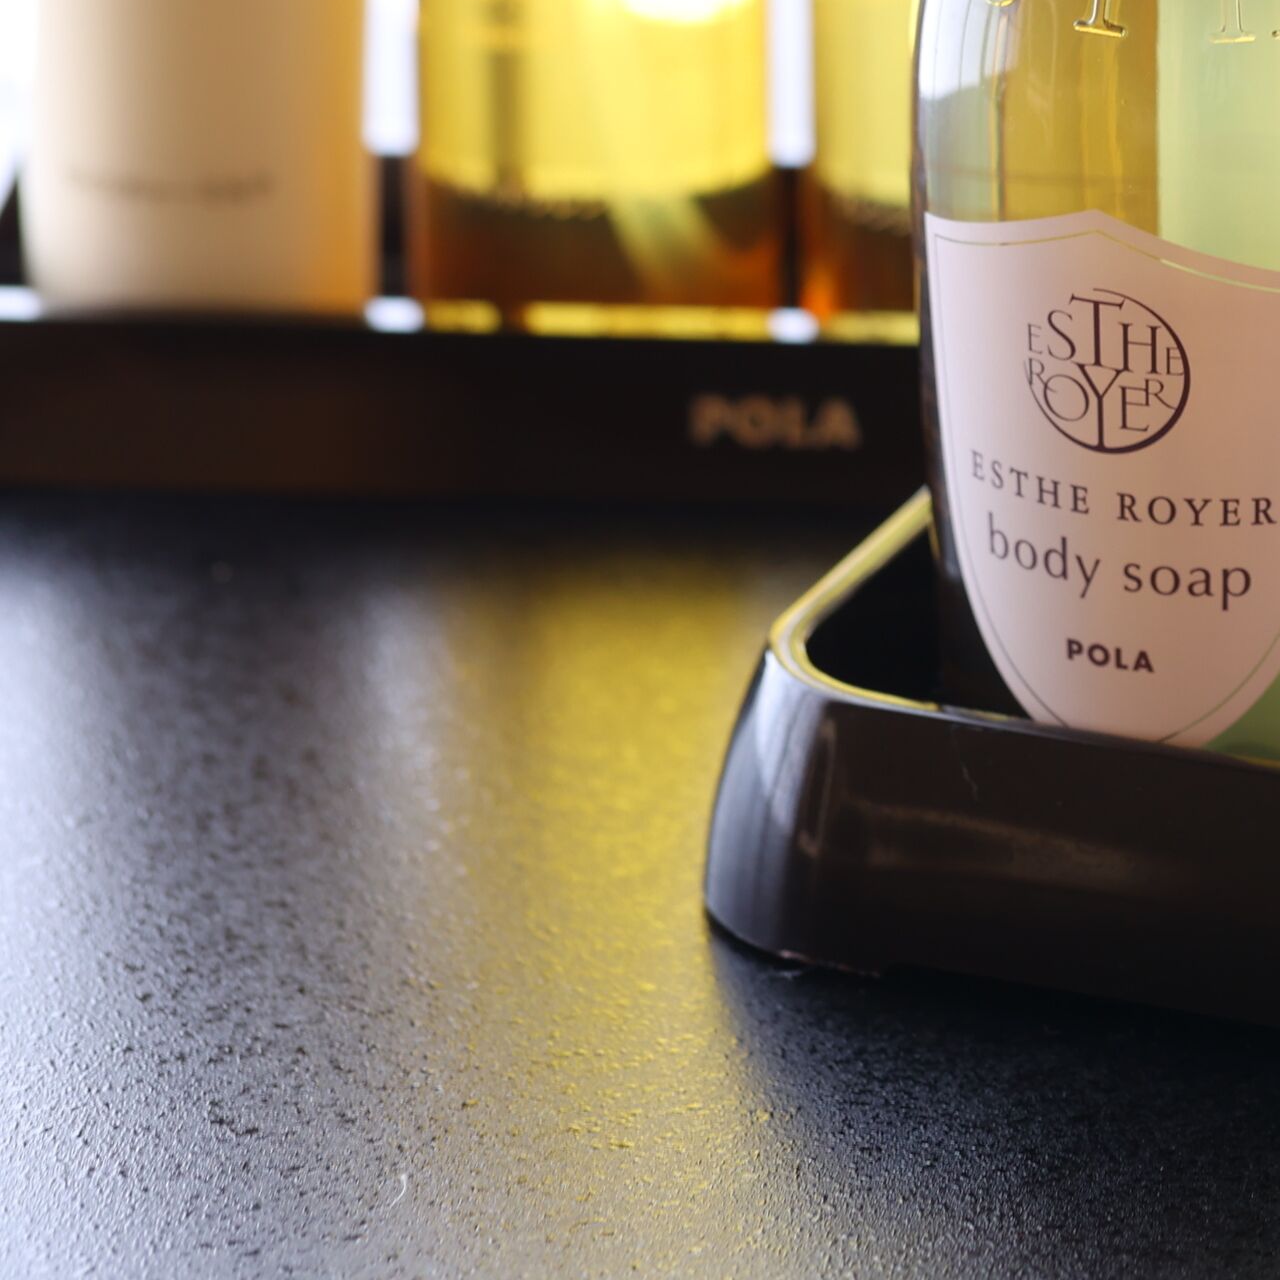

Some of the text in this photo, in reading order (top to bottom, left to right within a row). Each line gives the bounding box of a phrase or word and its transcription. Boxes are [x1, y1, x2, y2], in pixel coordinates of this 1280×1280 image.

[691, 394, 860, 450] POLA
[970, 449, 1278, 527] ESTHE ROYER
[987, 511, 1252, 611] body soap
[1066, 638, 1155, 674] POLA
